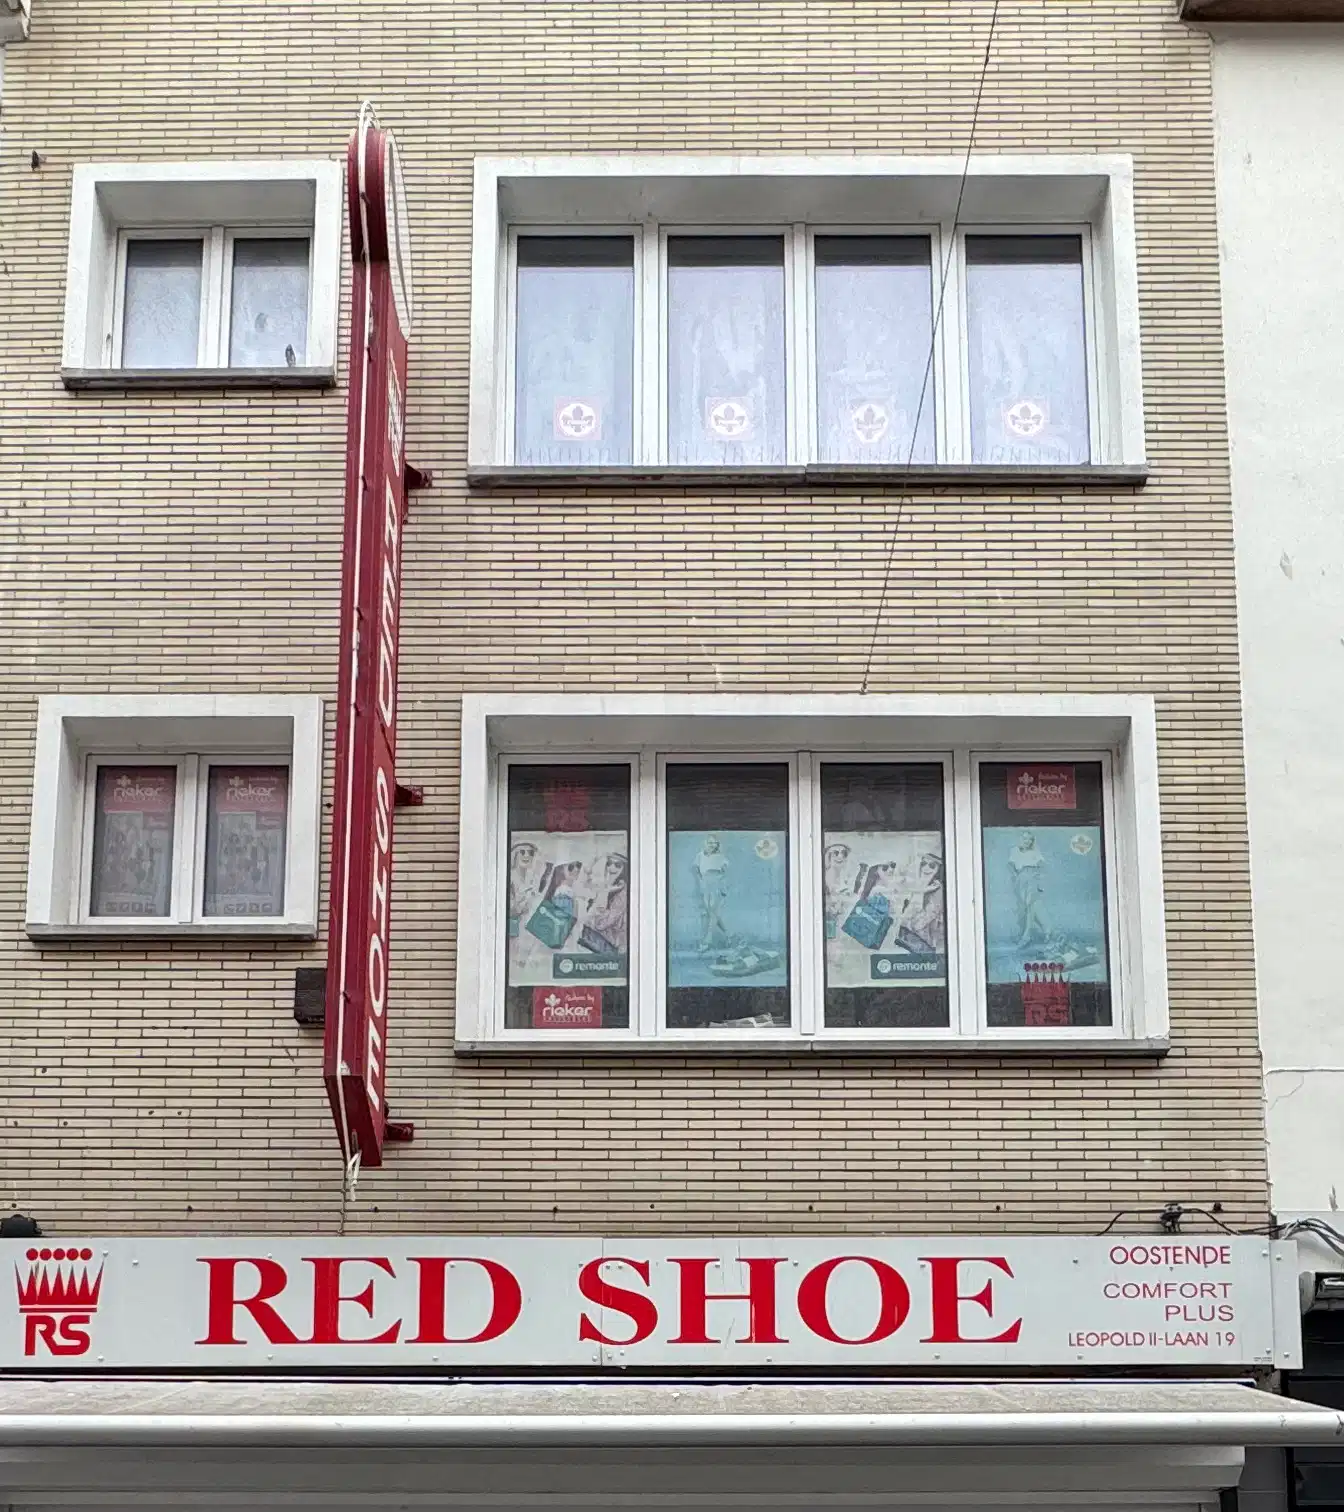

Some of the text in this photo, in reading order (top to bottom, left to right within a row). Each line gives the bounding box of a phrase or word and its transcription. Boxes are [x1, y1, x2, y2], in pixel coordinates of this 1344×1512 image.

[366, 766, 390, 1112] SHOE
[575, 961, 618, 971] remonte
[892, 962, 938, 971] remonte
[542, 1003, 594, 1017] rieker
[1109, 1245, 1232, 1265] OOSTENDE
[1103, 1282, 1233, 1299] COMFORT
[195, 1255, 1023, 1346] RED SHOE
[1164, 1304, 1234, 1322] PLUS
[24, 1314, 93, 1356] RS
[1068, 1332, 1235, 1347] LEOPOLD II-LAAN 19
